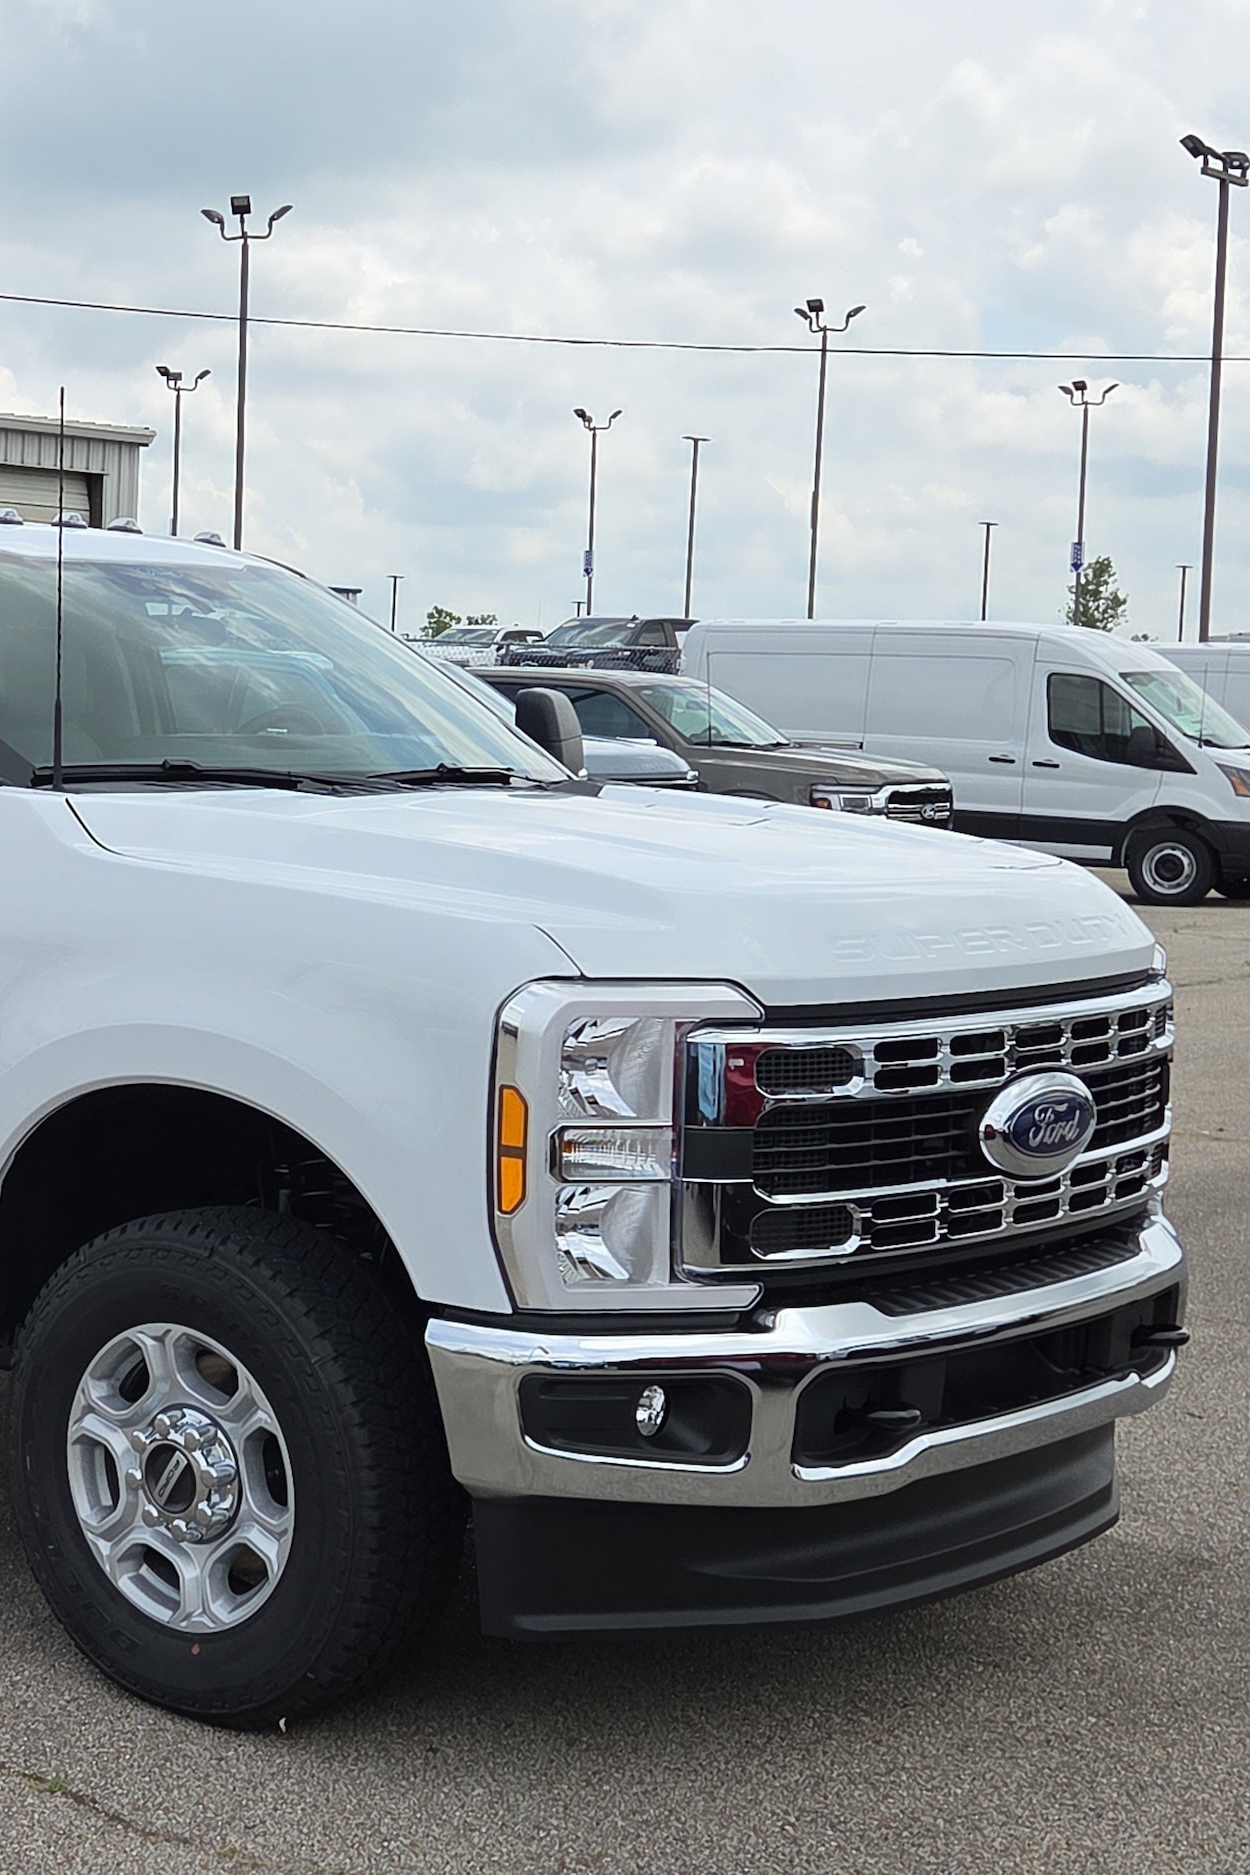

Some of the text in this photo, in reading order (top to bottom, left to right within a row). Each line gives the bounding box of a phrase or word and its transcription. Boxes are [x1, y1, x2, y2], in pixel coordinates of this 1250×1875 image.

[831, 912, 1128, 962] SUPER DUTY
[1029, 1103, 1080, 1147] Ford
[158, 1459, 180, 1498] FORD
